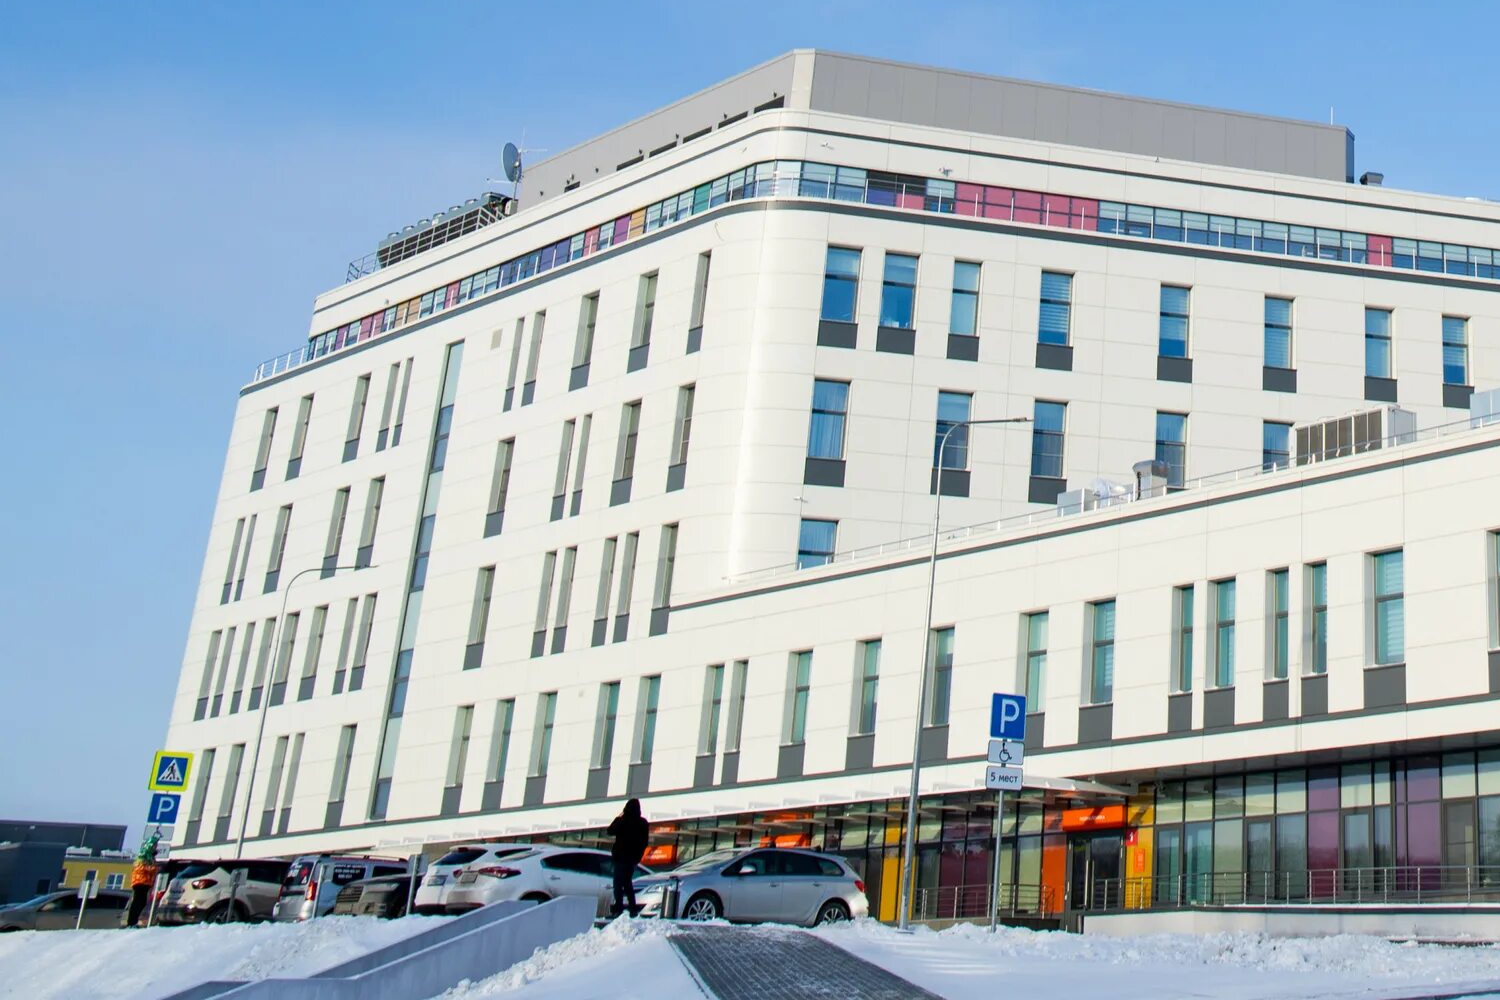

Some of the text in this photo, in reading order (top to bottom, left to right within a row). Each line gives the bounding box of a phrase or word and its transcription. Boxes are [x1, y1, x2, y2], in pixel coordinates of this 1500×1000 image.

[999, 698, 1020, 734] P
[990, 771, 1019, 784] 5 мест
[156, 796, 175, 820] P
